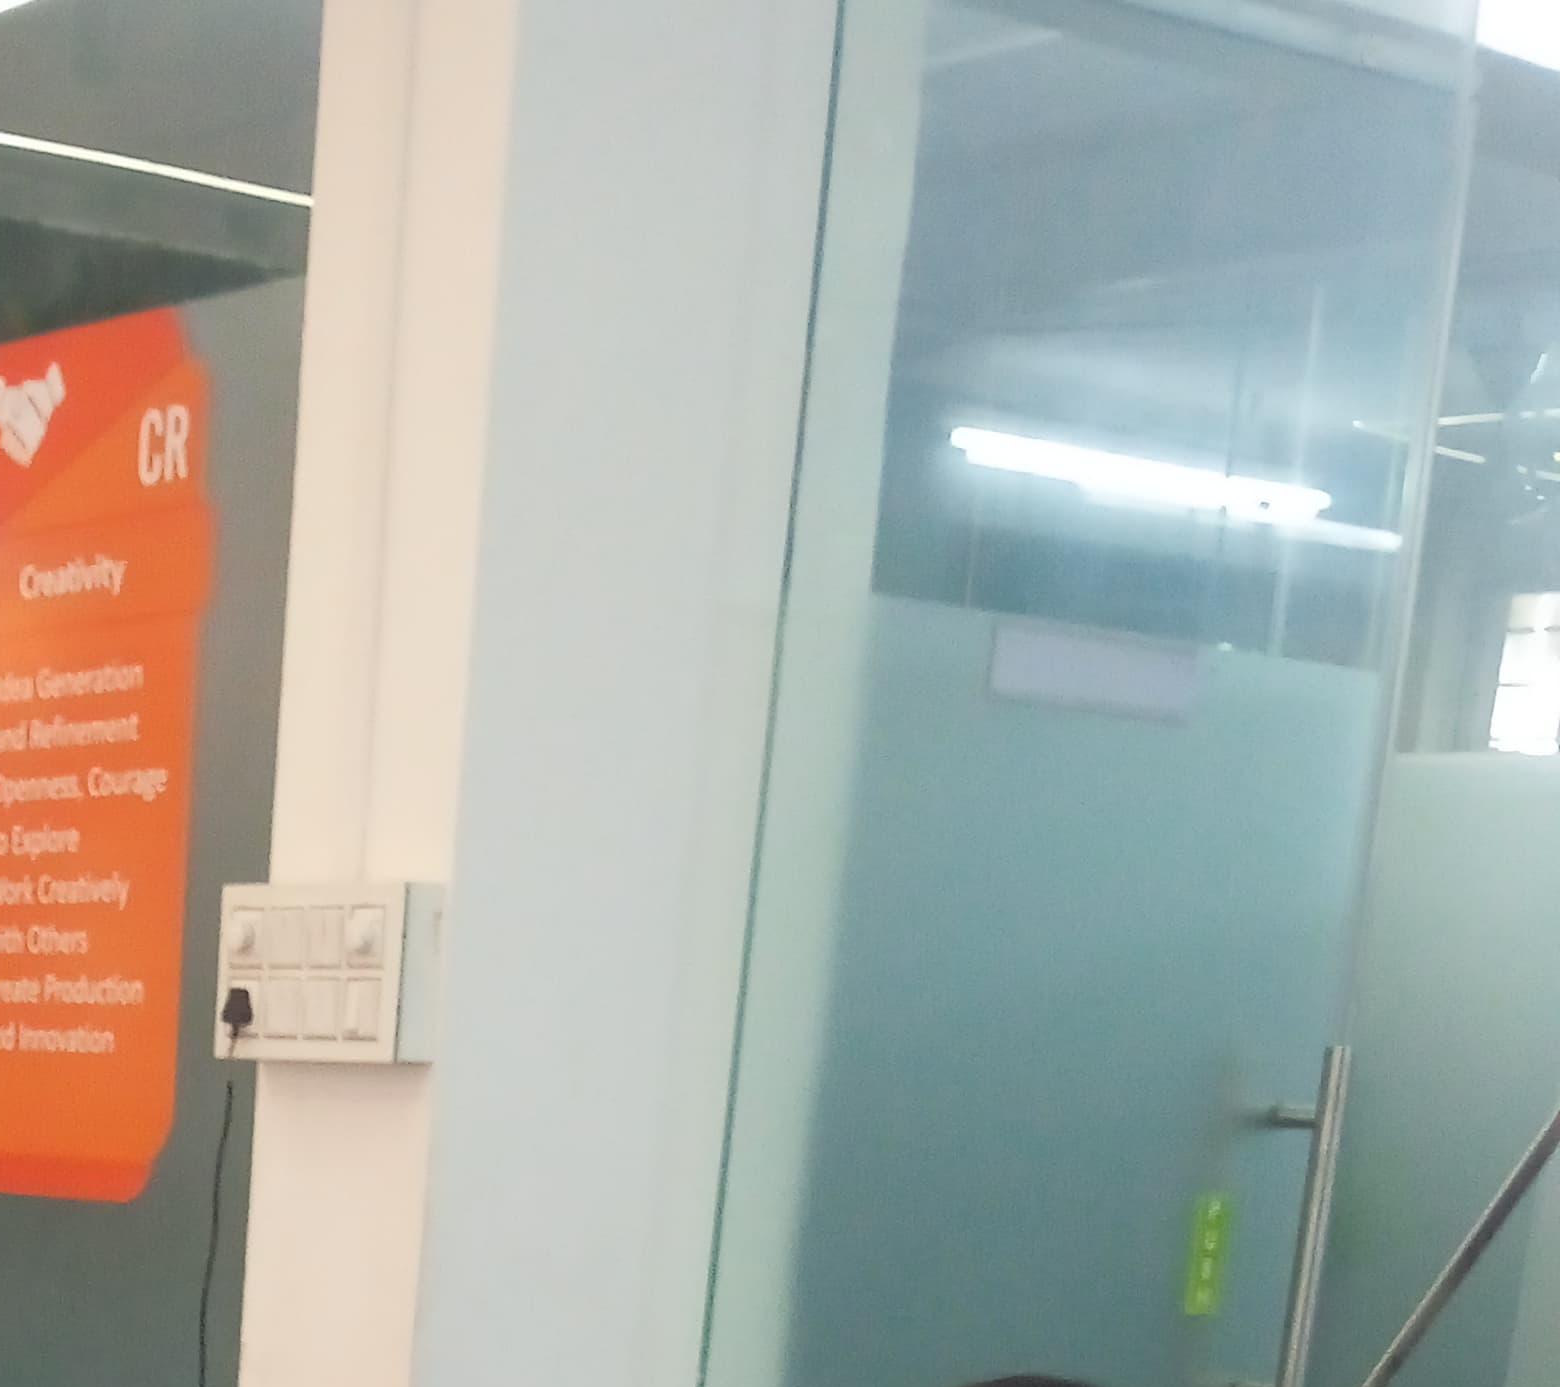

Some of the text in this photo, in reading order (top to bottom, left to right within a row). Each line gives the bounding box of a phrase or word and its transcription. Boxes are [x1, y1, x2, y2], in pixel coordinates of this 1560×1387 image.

[138, 404, 190, 486] CR
[19, 554, 128, 600] Creativity
[36, 664, 144, 699] Generation
[29, 714, 139, 750] Refinement
[88, 767, 169, 803] Courage
[12, 825, 80, 861] Explore
[37, 871, 130, 911] Creatively
[26, 925, 88, 954] Others
[43, 974, 145, 1006] Production
[18, 1024, 115, 1054] Innovation
